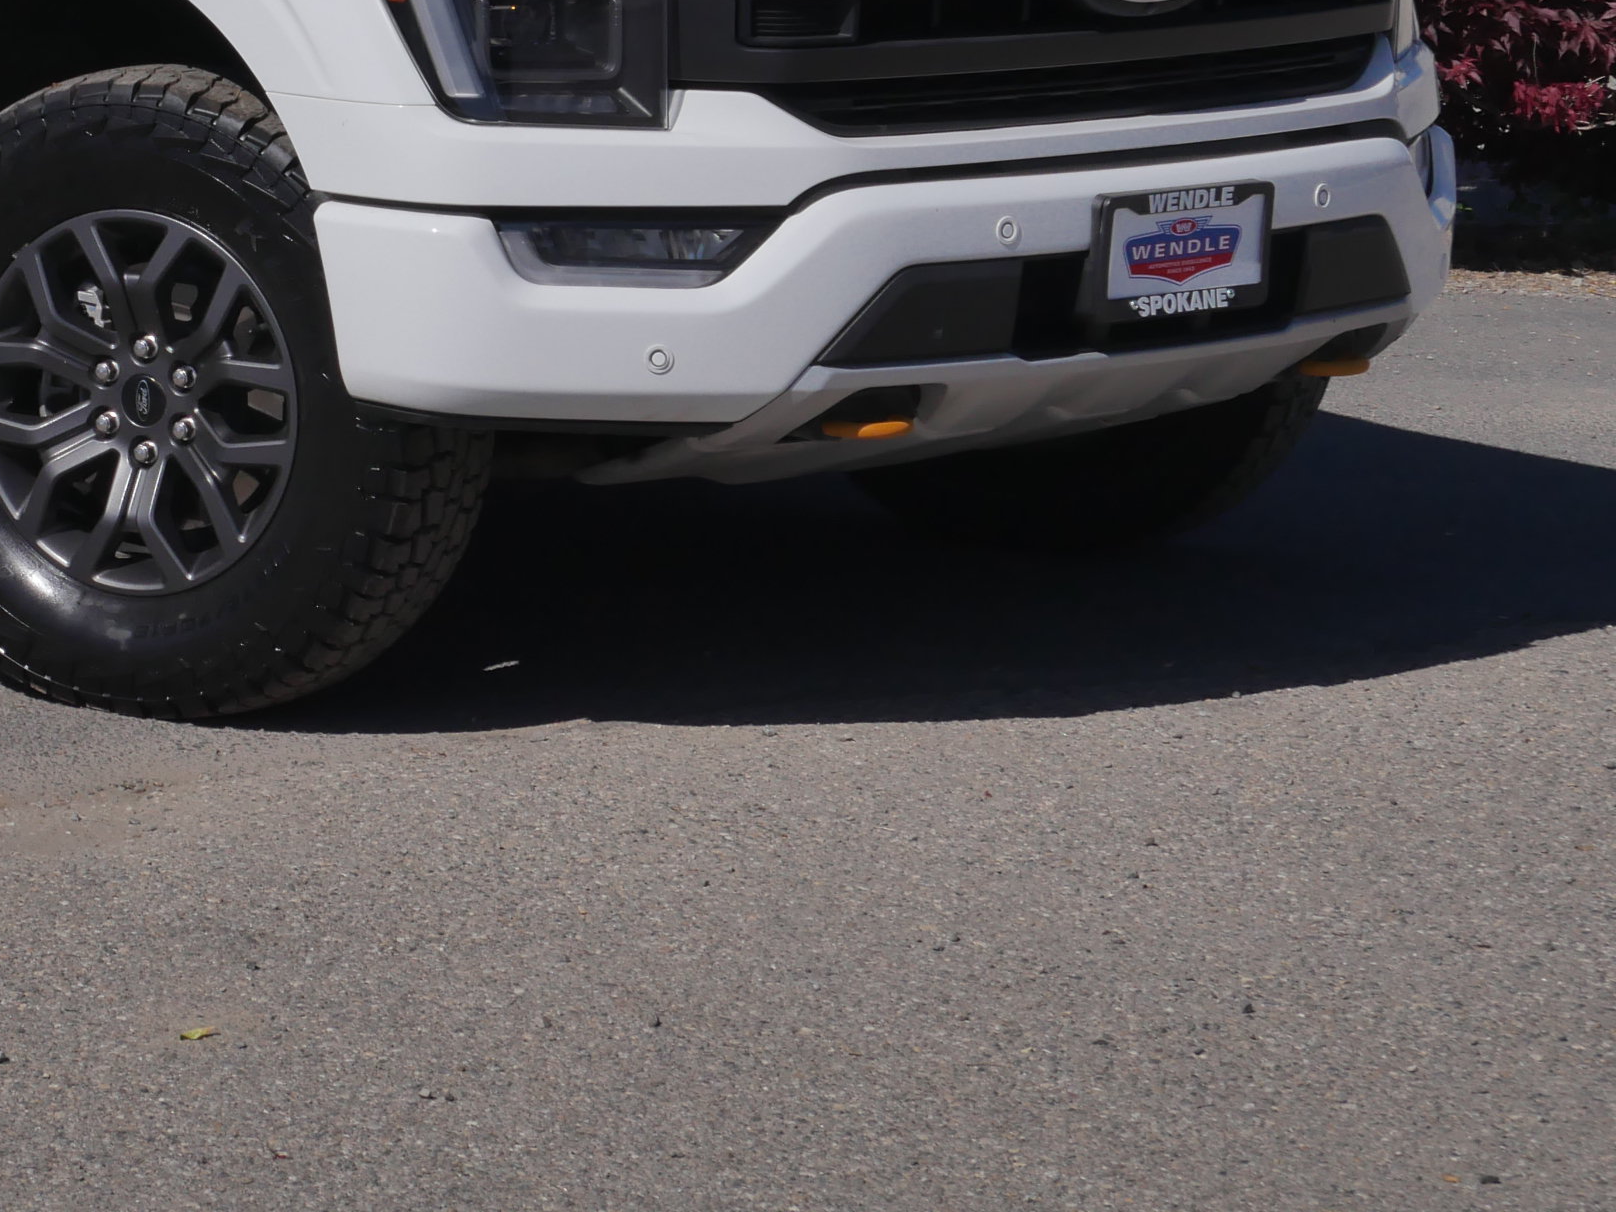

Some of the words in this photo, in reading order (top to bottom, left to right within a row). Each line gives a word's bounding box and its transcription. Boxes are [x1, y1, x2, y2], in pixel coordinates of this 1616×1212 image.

[1148, 186, 1235, 215] WENDLE
[1131, 235, 1231, 261] WENDLE
[1137, 287, 1229, 318] SPOKANE
